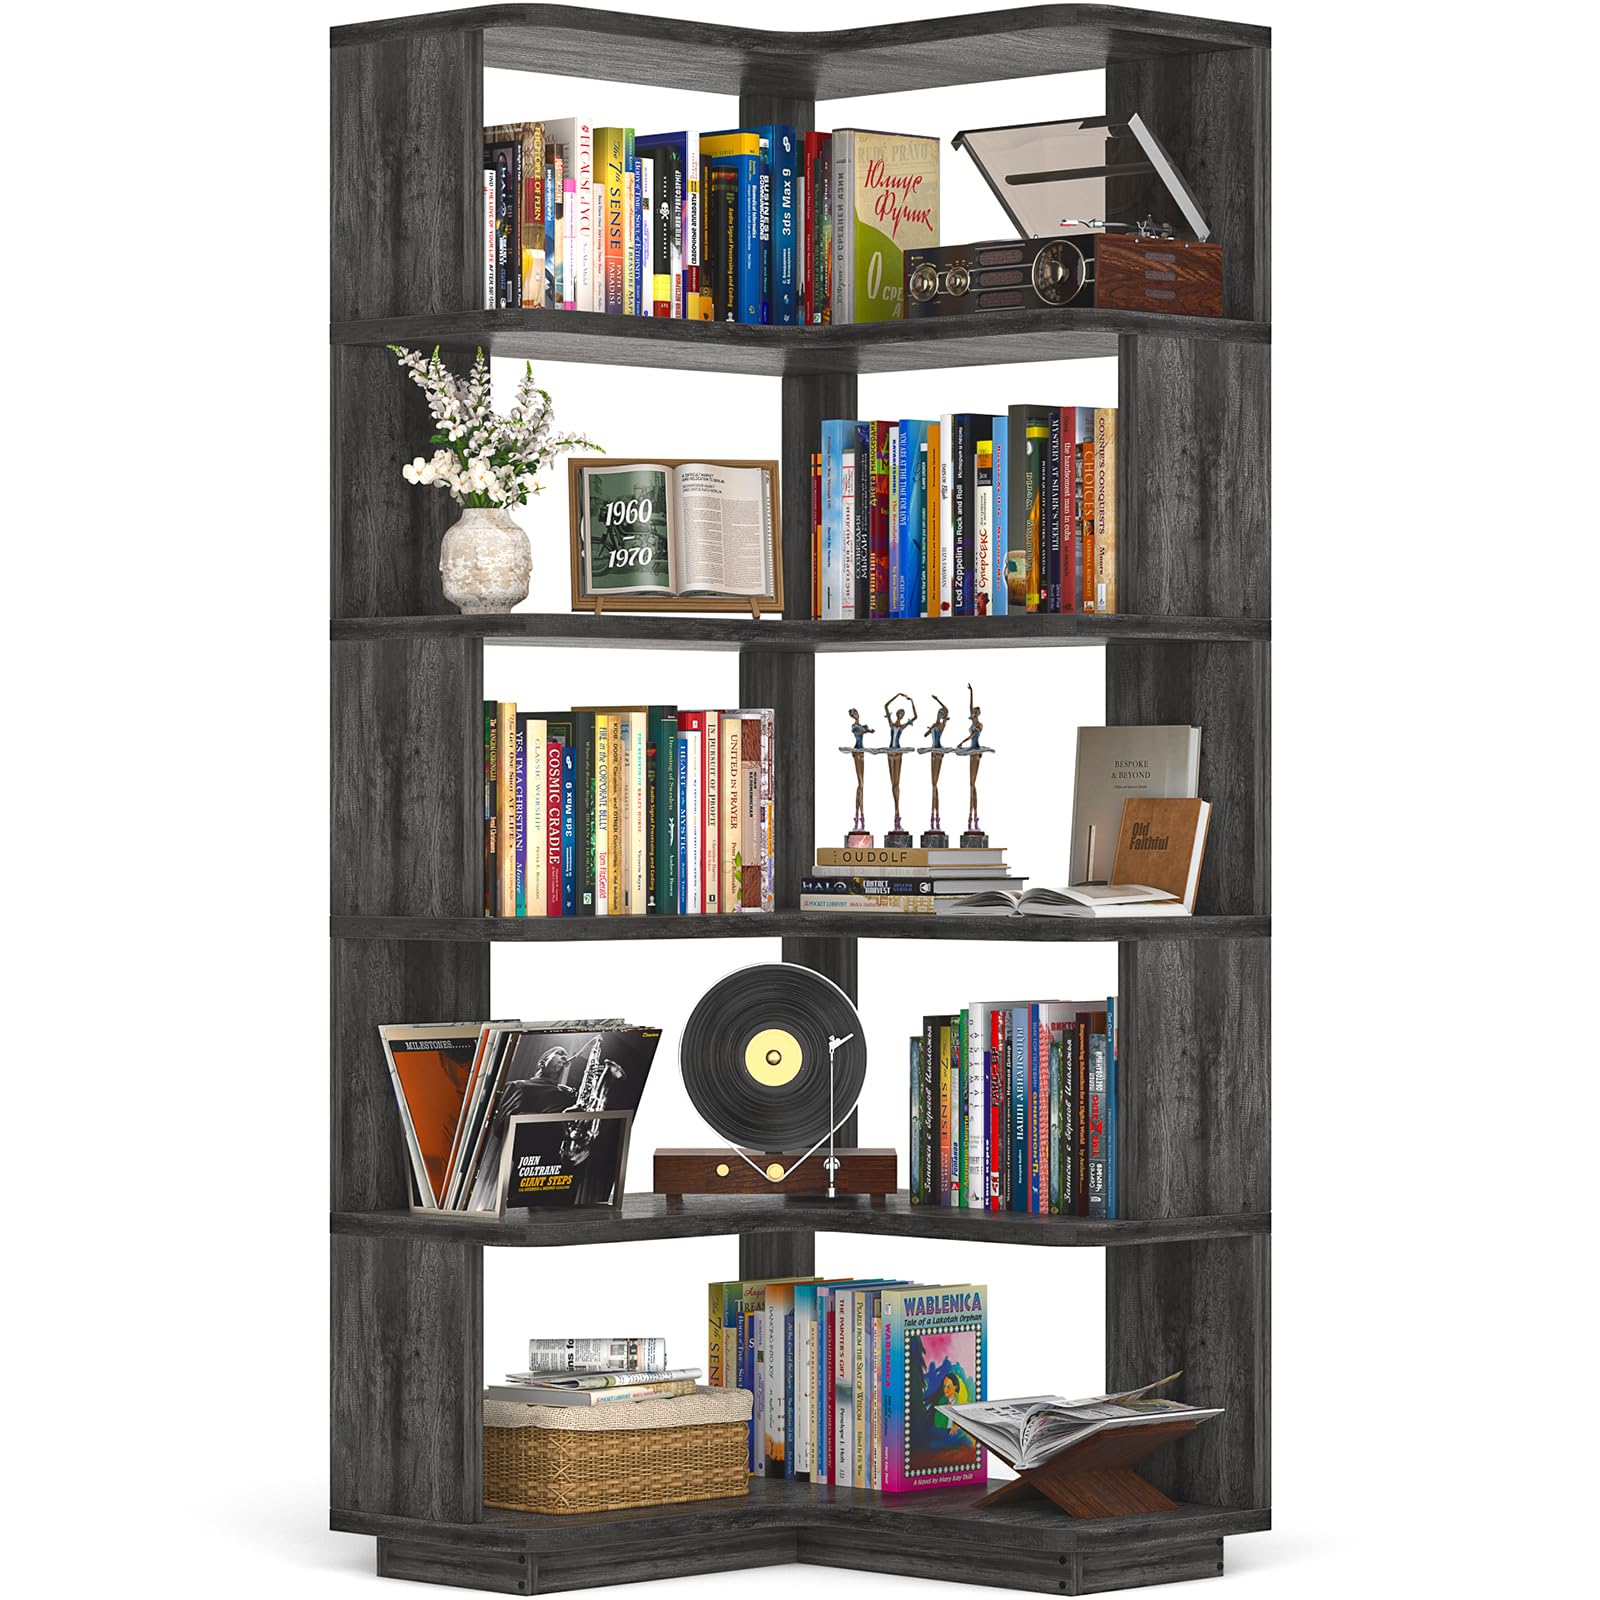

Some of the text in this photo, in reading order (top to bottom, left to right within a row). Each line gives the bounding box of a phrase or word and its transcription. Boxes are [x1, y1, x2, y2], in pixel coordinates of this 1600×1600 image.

[534, 181, 541, 194] OF
[864, 159, 923, 200] Юлиус
[782, 168, 791, 236] 3ds Max 9
[609, 187, 621, 249] SENSE
[874, 189, 933, 241] Фучик
[868, 251, 883, 299] О
[616, 292, 622, 304] TO
[1063, 442, 1071, 454] the
[1051, 419, 1059, 551] MYSTERY AT SHARK'S TEETH
[1063, 455, 1071, 497] handsomest
[1083, 450, 1094, 517] CHOICES
[605, 499, 653, 526] 1960
[1063, 498, 1071, 514] man
[1063, 524, 1071, 541] cuba
[608, 547, 653, 569] 1970
[955, 546, 965, 587] Zeppelin
[979, 528, 989, 588] СуперСЕКС
[955, 589, 963, 607] Led
[599, 727, 607, 741] FIRE
[515, 757, 523, 775] I'M
[599, 751, 607, 763] the
[1114, 760, 1149, 768] BESPOKE
[515, 777, 523, 785] A
[549, 748, 560, 804] COSMIC
[599, 764, 607, 807] CORPORATE
[668, 773, 675, 781] of
[730, 734, 738, 830] UNITED IN PRAYER
[565, 792, 573, 814] Max
[515, 787, 523, 852] CHRISTIAN!
[565, 817, 573, 837] 3ds
[599, 809, 607, 831] BELLY
[1132, 822, 1149, 837] Old
[549, 807, 560, 865] CRADLE
[1129, 835, 1170, 850] Faithful
[842, 851, 908, 862] OUDOLF
[599, 851, 607, 899] Tom FitzGerald
[802, 881, 847, 889] HALO
[862, 880, 888, 888] CONTACT
[1016, 1026, 1025, 1141] НАШИ АВИАНОСЦЫ
[924, 1087, 934, 1128] берегов
[1064, 1100, 1074, 1141] берегов
[518, 1155, 541, 1169] JOHN
[518, 1165, 562, 1177] COLTRANE
[520, 1175, 573, 1187] GIANT STEPS
[1064, 1156, 1072, 1203] Записки
[904, 1292, 982, 1317] WABLENICA
[904, 1319, 917, 1327] Tale
[918, 1317, 927, 1326] of
[932, 1315, 958, 1324] Lakotah
[959, 1314, 982, 1323] Orphan
[918, 1477, 932, 1486] Novel
[932, 1476, 939, 1486] by
[939, 1476, 952, 1485] Mary
[952, 1475, 961, 1484] Kay
